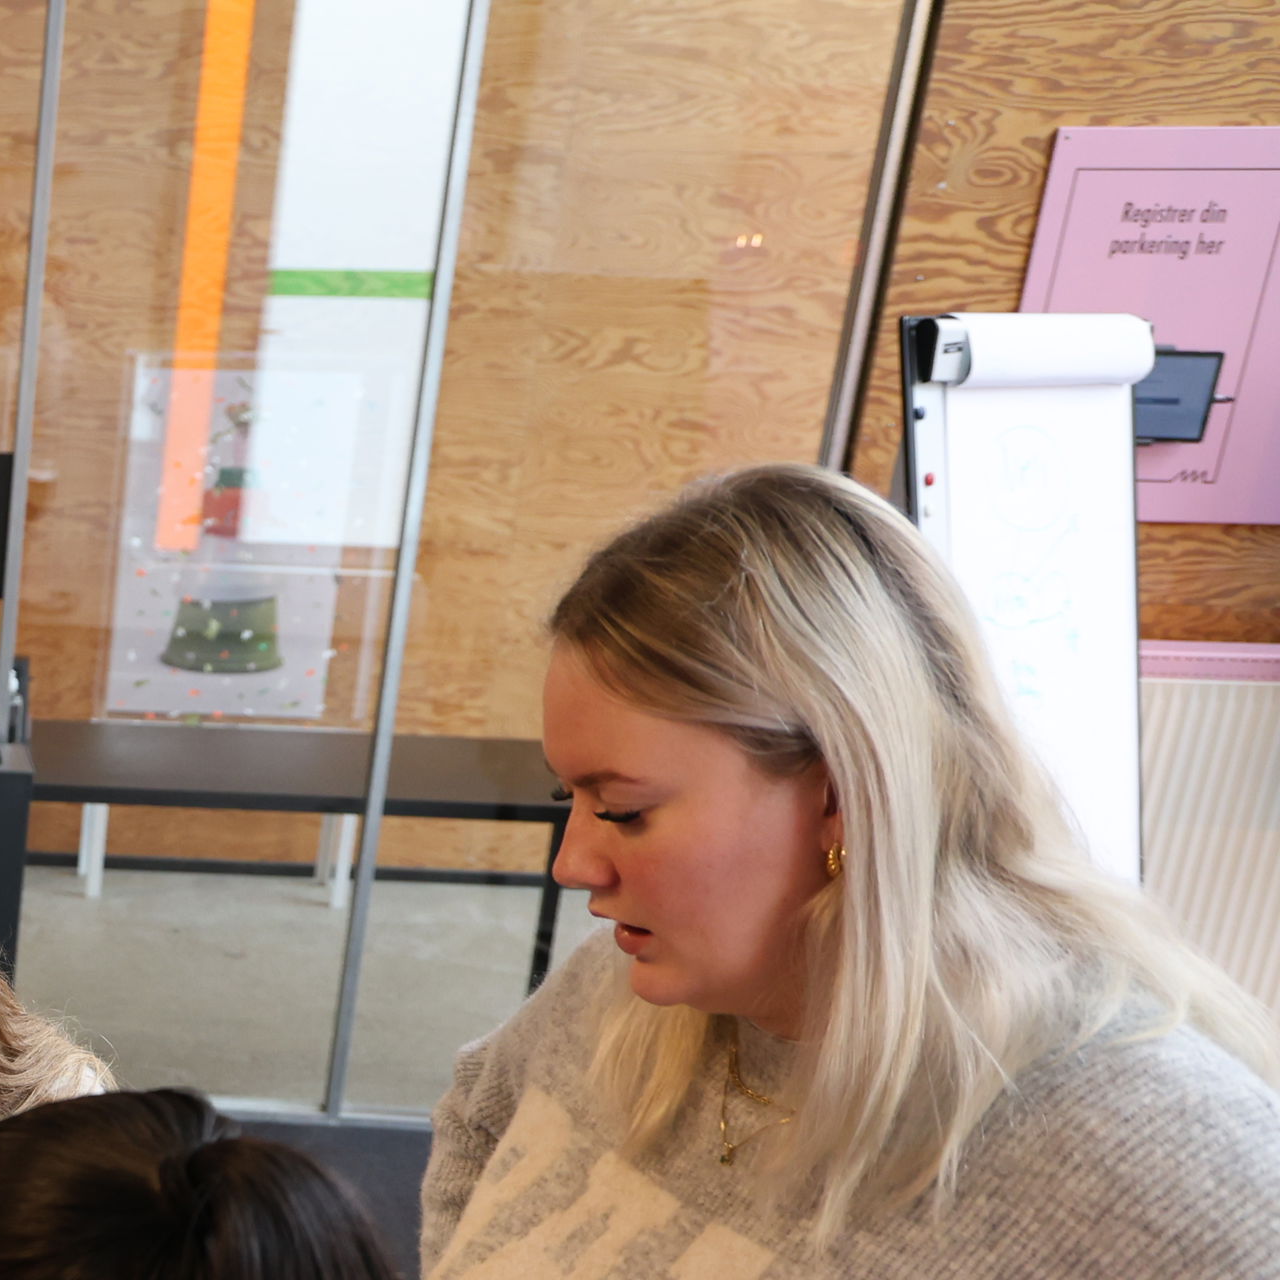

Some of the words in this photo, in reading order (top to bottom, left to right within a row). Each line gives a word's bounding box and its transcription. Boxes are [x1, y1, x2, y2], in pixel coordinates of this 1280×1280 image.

[1121, 202, 1196, 228] Registrer
[1200, 200, 1227, 223] din
[1108, 232, 1192, 259] parkering
[1195, 232, 1225, 254] her
